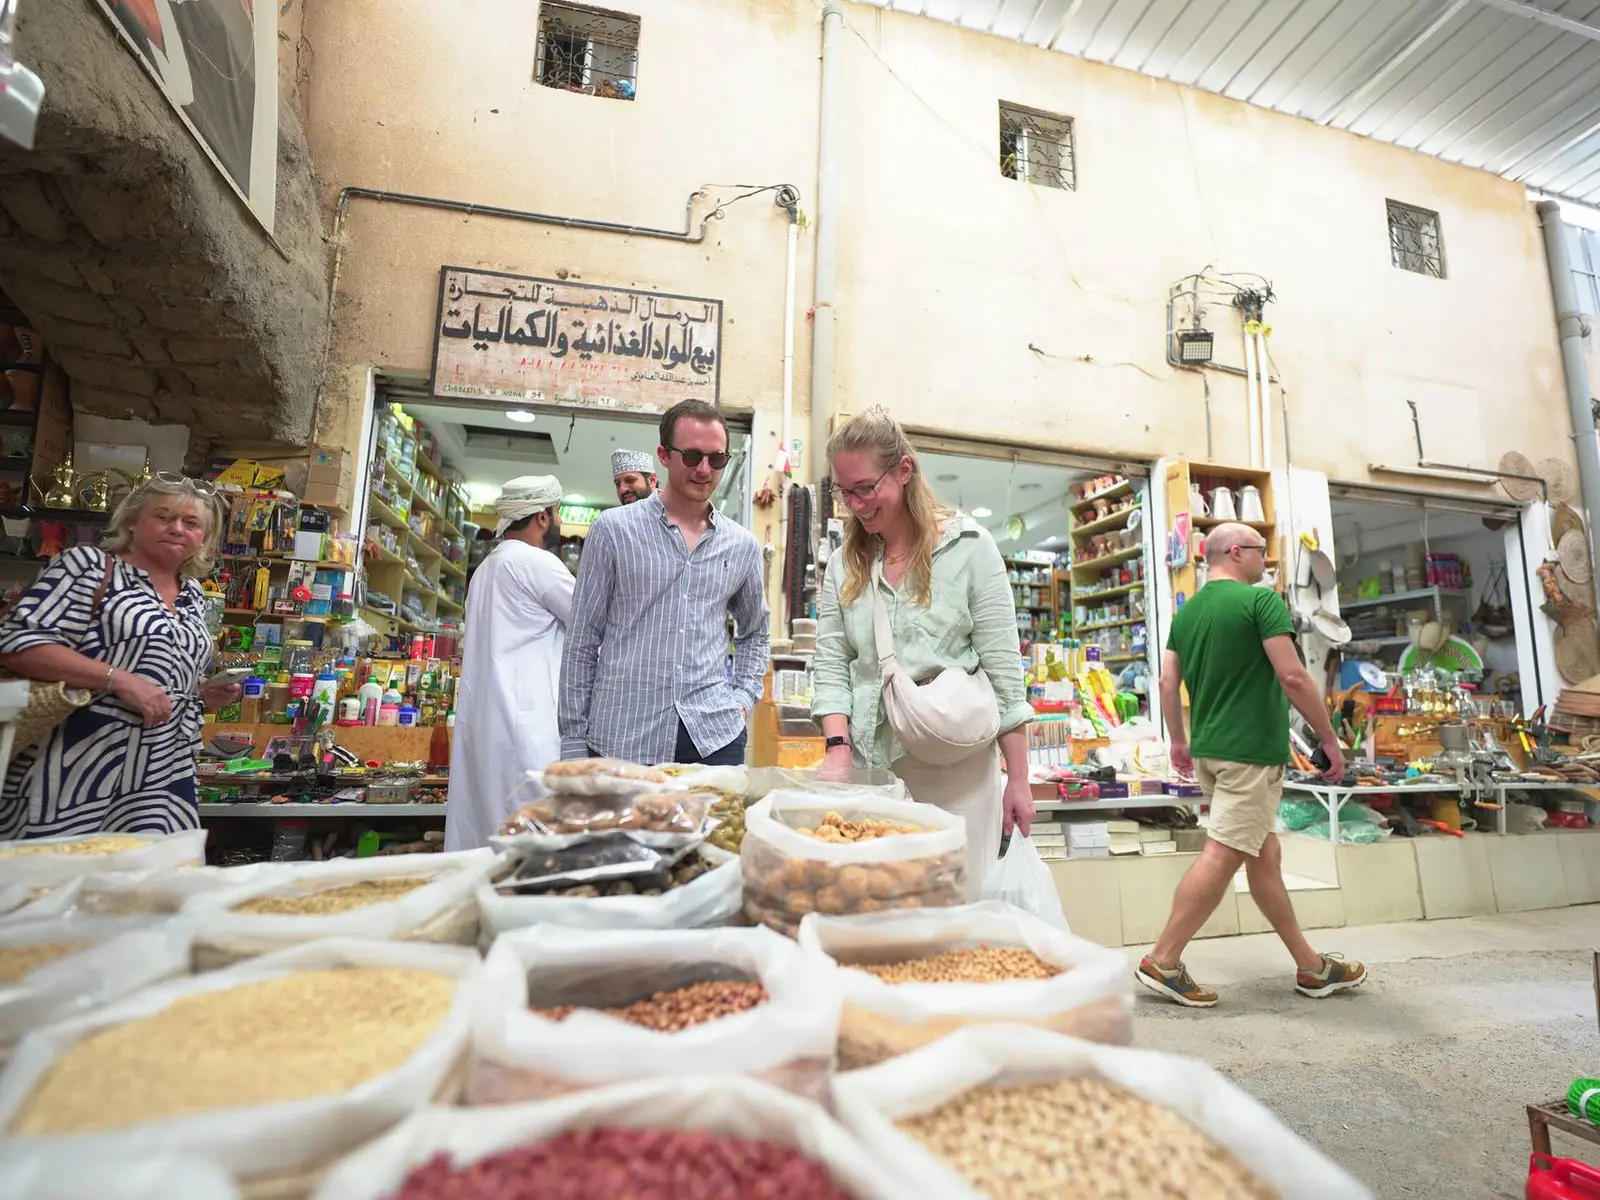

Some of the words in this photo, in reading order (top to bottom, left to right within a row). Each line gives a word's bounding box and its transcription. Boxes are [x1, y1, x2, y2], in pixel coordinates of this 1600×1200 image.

[448, 275, 543, 305] للتجارة
[545, 286, 638, 316] الذهبية
[639, 297, 713, 327] الرمال
[442, 302, 569, 358] والكماليات
[571, 318, 653, 360] الغذائية
[652, 324, 693, 371] المواد
[691, 345, 715, 375] بيع
